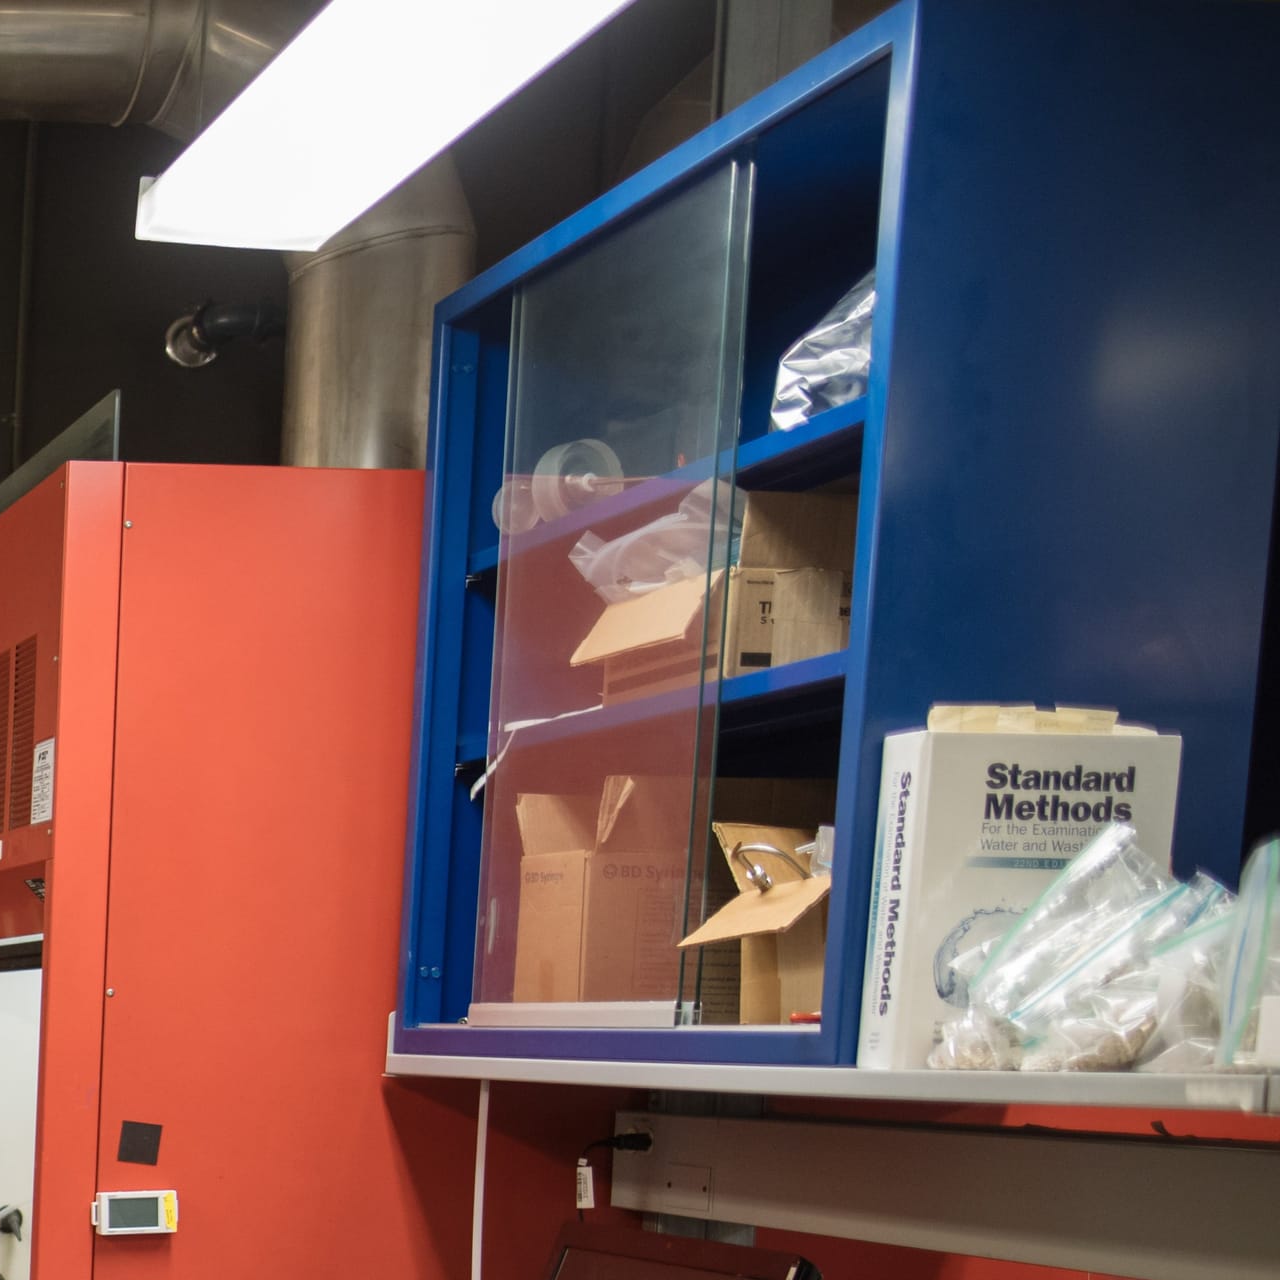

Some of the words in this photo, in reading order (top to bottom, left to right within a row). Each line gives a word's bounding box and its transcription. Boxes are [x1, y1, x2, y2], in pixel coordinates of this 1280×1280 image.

[985, 762, 1136, 792] Standard
[984, 793, 1132, 822] Methods
[890, 770, 912, 891] Standard
[982, 823, 1001, 835] For
[1007, 823, 1027, 836] the
[1032, 823, 1100, 837] Examinati
[981, 839, 1018, 851] Water
[1022, 840, 1047, 852] and
[878, 898, 901, 1017] Methods
